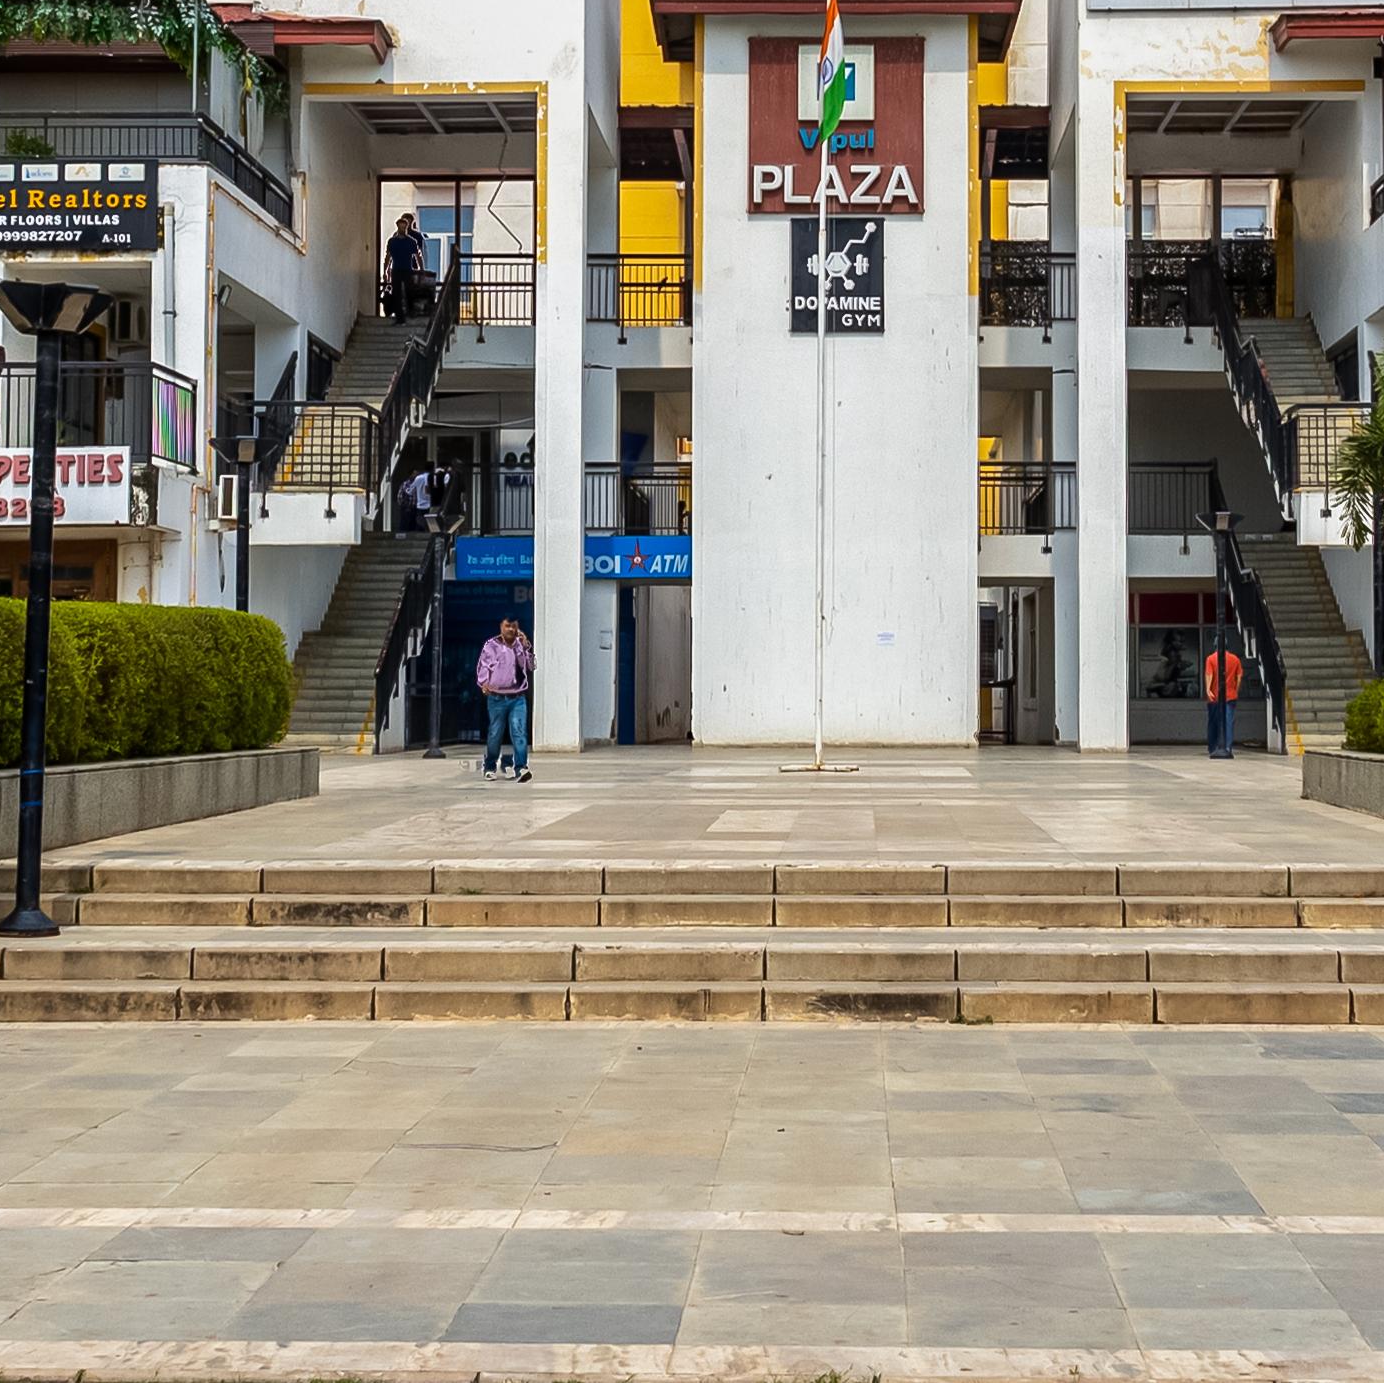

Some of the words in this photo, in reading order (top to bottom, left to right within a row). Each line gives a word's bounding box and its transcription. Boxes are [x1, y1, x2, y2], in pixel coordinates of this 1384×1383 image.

[799, 128, 874, 152] Vpul
[753, 165, 918, 204] PLAZA
[27, 189, 147, 209] Realtors
[10, 215, 62, 225] FLOORS
[73, 215, 120, 225] VILLAS
[842, 315, 881, 327] GYM
[650, 555, 688, 573] ATM
